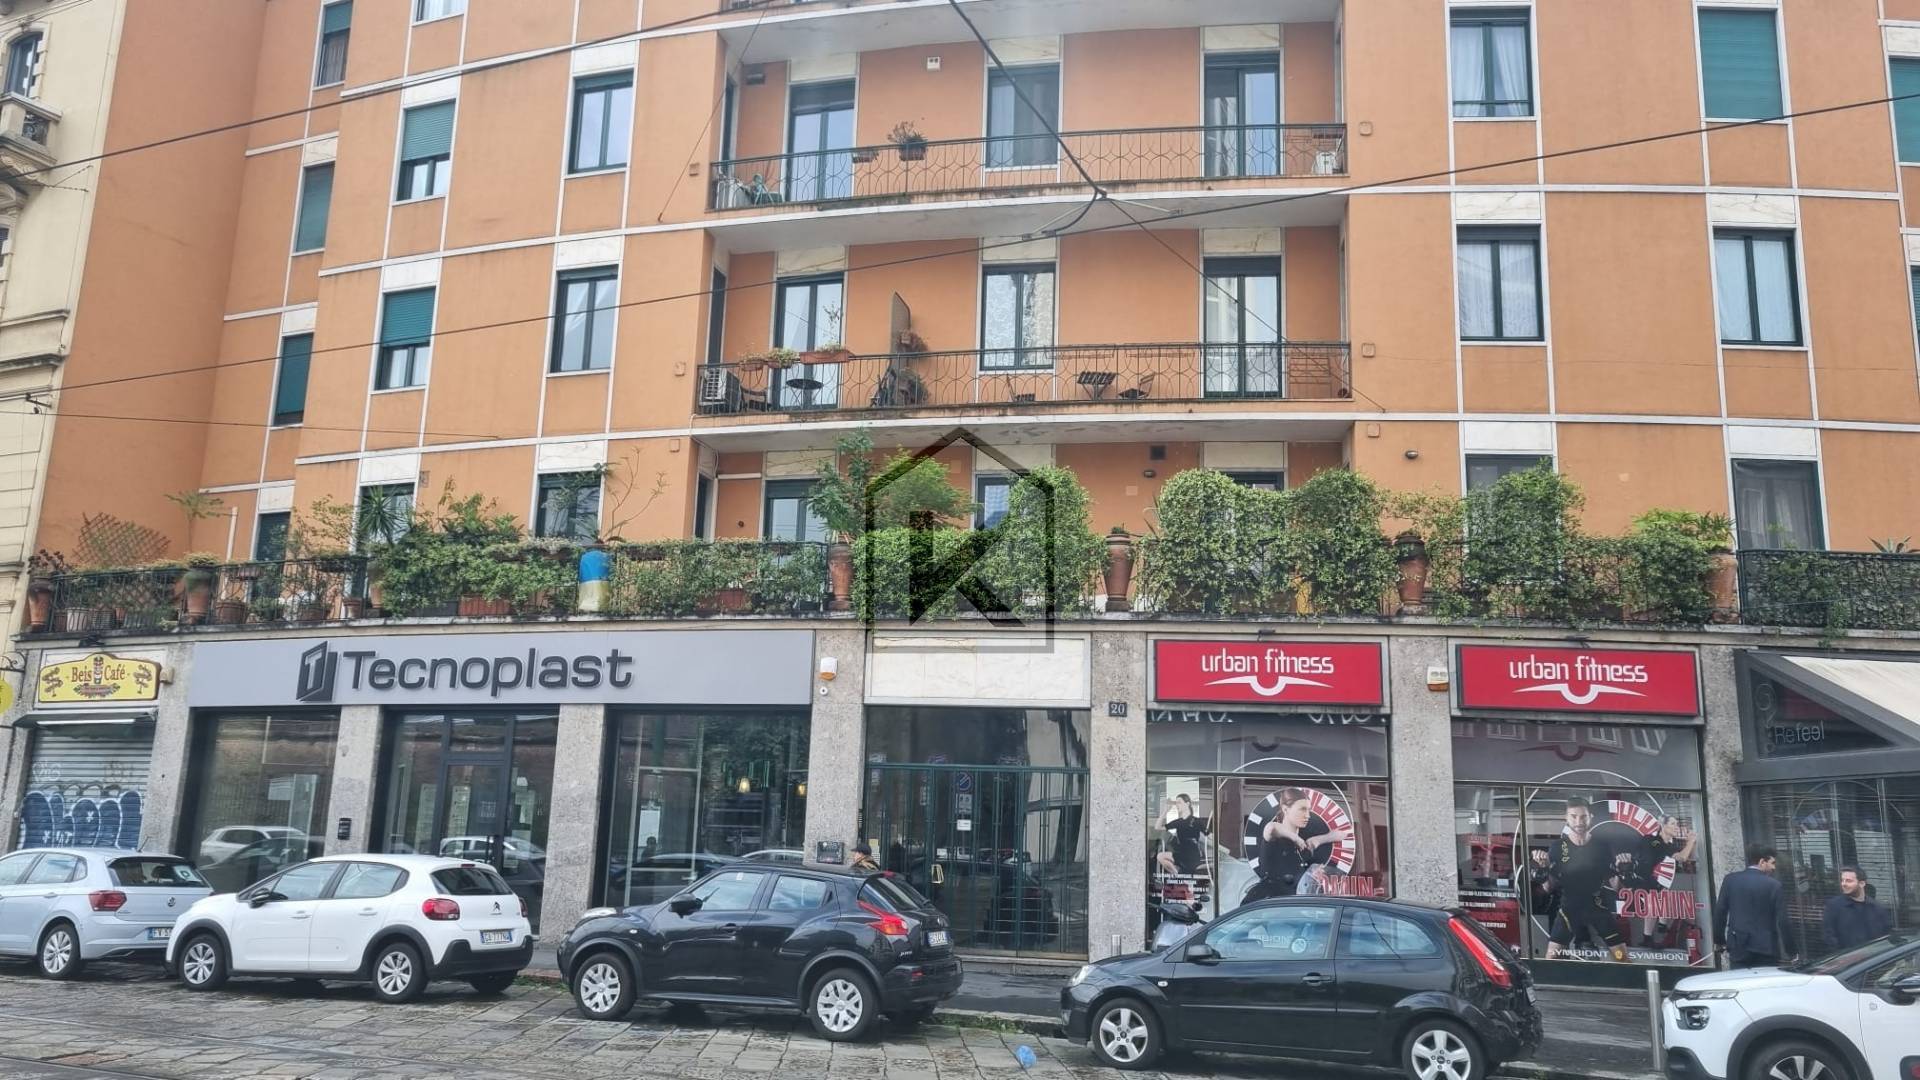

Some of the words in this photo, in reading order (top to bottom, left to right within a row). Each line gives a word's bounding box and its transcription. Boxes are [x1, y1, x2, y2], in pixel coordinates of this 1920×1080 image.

[342, 647, 633, 697] Tecnoplast
[1202, 648, 1258, 673] urban
[1264, 648, 1334, 674] fitness
[1509, 653, 1569, 681] urban
[1574, 655, 1648, 683] fitness
[71, 665, 92, 682] Beis
[104, 664, 125, 681] Café
[1110, 703, 1125, 714] 20
[1550, 948, 1609, 959] SYMBIONT
[1628, 951, 1689, 961] SYMBIONT
